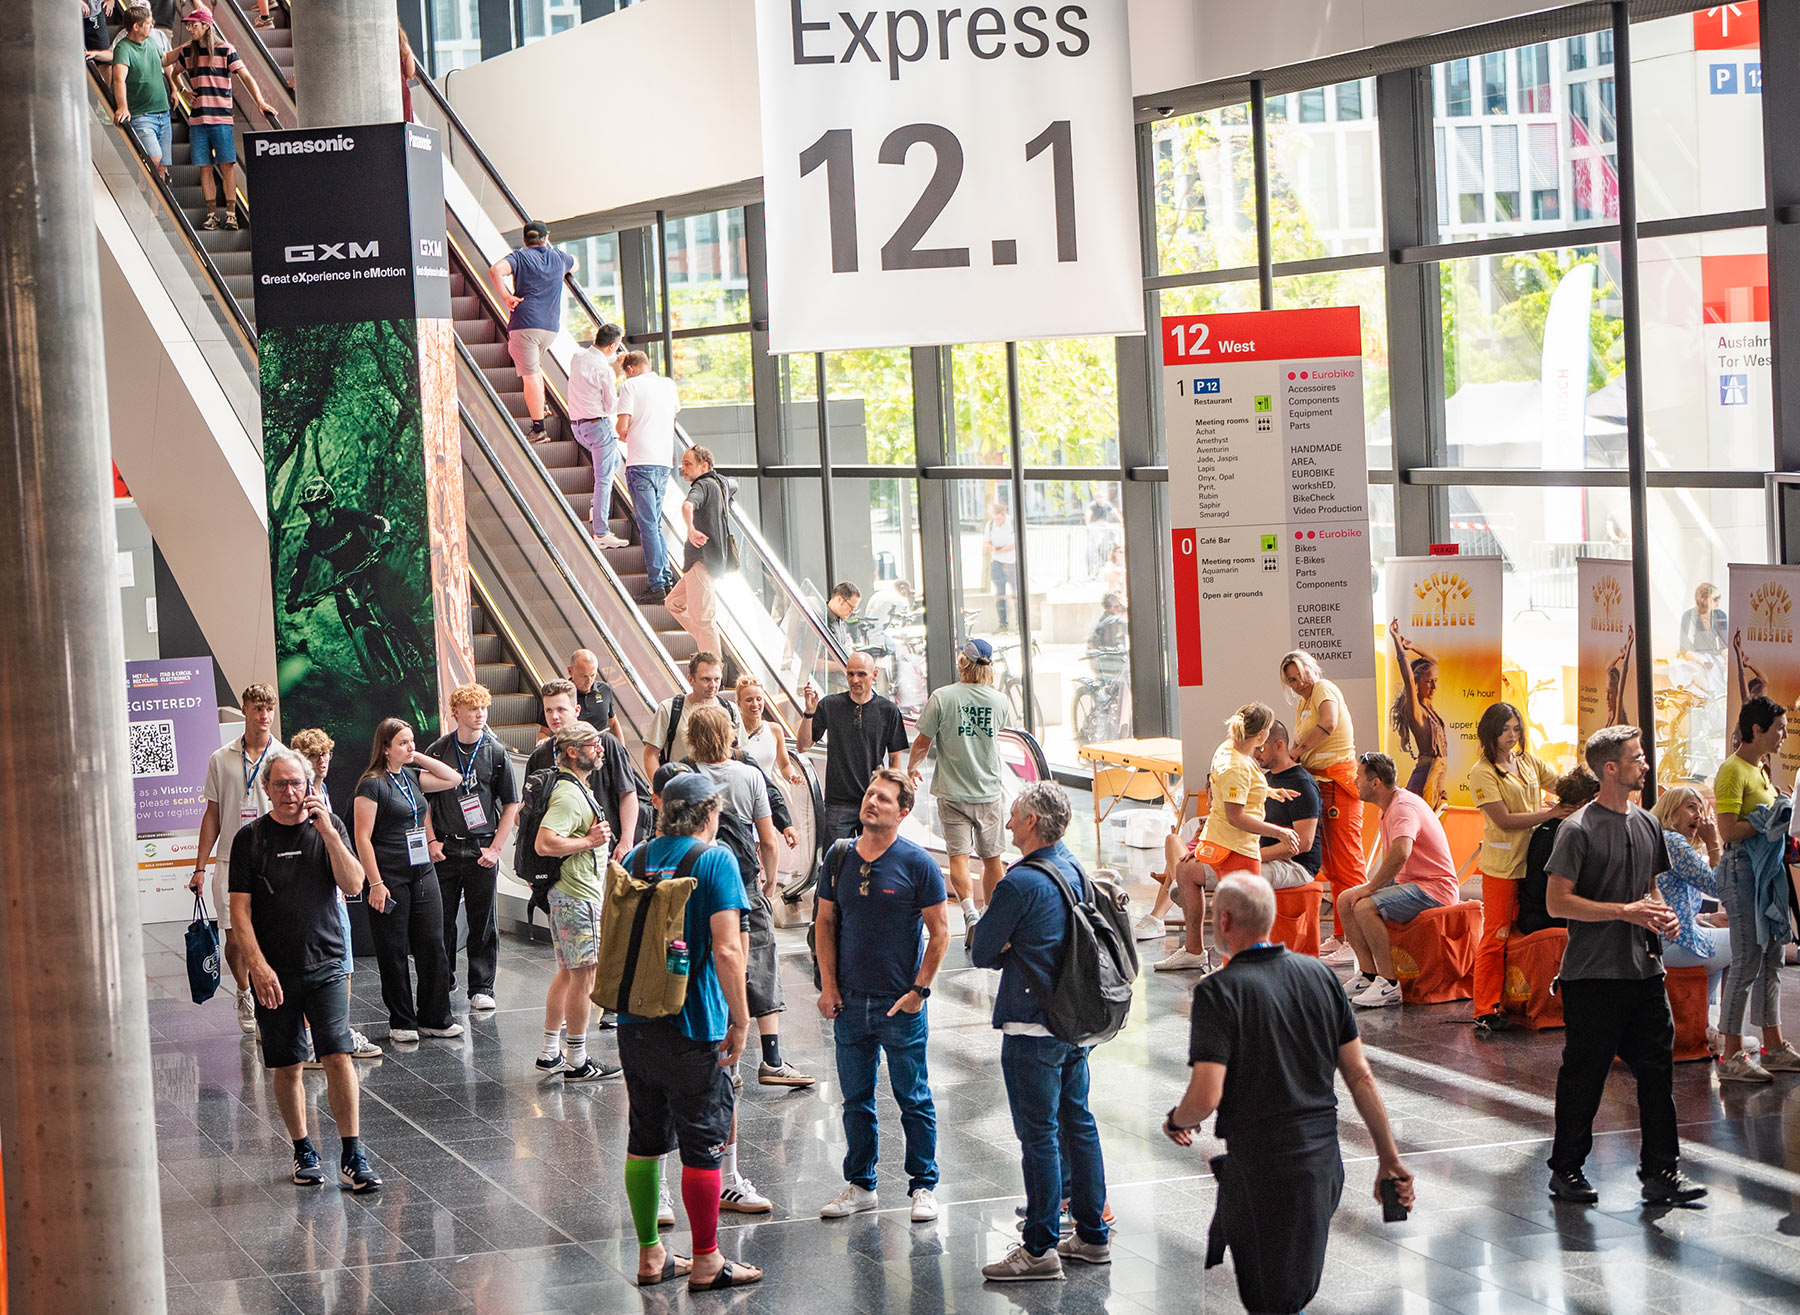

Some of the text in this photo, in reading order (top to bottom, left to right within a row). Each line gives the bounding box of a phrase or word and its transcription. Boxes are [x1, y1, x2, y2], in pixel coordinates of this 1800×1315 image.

[791, 0, 1090, 80] Express
[1716, 68, 1730, 89] P
[255, 134, 355, 156] Panasonic
[799, 120, 1078, 273] 12.1
[284, 240, 379, 262] GXM
[420, 239, 442, 257] GXM
[261, 274, 290, 285] Great
[292, 270, 350, 284] eXperience
[353, 270, 362, 279] in
[363, 267, 406, 278] eMotion
[1171, 323, 1256, 356] 12 West
[1718, 335, 1771, 349] Ausfahr
[1718, 354, 1772, 368] Tor Wes
[1312, 369, 1355, 379] Eurobike
[1177, 380, 1184, 396] 1
[1197, 381, 1217, 392] P 12
[1288, 384, 1336, 393] Accessoires
[1289, 396, 1340, 406] Components
[1289, 409, 1333, 419] Equipment
[1291, 443, 1342, 454] HANDMADE
[1291, 457, 1317, 466] AREA,
[1292, 469, 1334, 478] EUROBIKE
[1292, 480, 1335, 490] workshED,
[1293, 494, 1335, 503] BikeCheck
[1293, 504, 1362, 515] Video Production
[1319, 529, 1362, 539] Eurobike
[1182, 538, 1192, 555] 0
[1295, 556, 1325, 564] E-Bikes
[1296, 580, 1348, 590] Components
[1234, 590, 1263, 599] grounds
[1298, 603, 1340, 612] EUROBIKE
[1298, 616, 1332, 625] CAREER
[1412, 613, 1475, 627] MASSAGE
[1298, 628, 1334, 637] CENTER,
[1299, 640, 1342, 649] EUROBIKE
[1463, 688, 1495, 698] 1/4 hour
[128, 696, 202, 712] EGISTERED?
[963, 717, 991, 727] AFF
[1450, 722, 1472, 730] upper
[160, 786, 193, 794] Visitor
[140, 799, 169, 809] please
